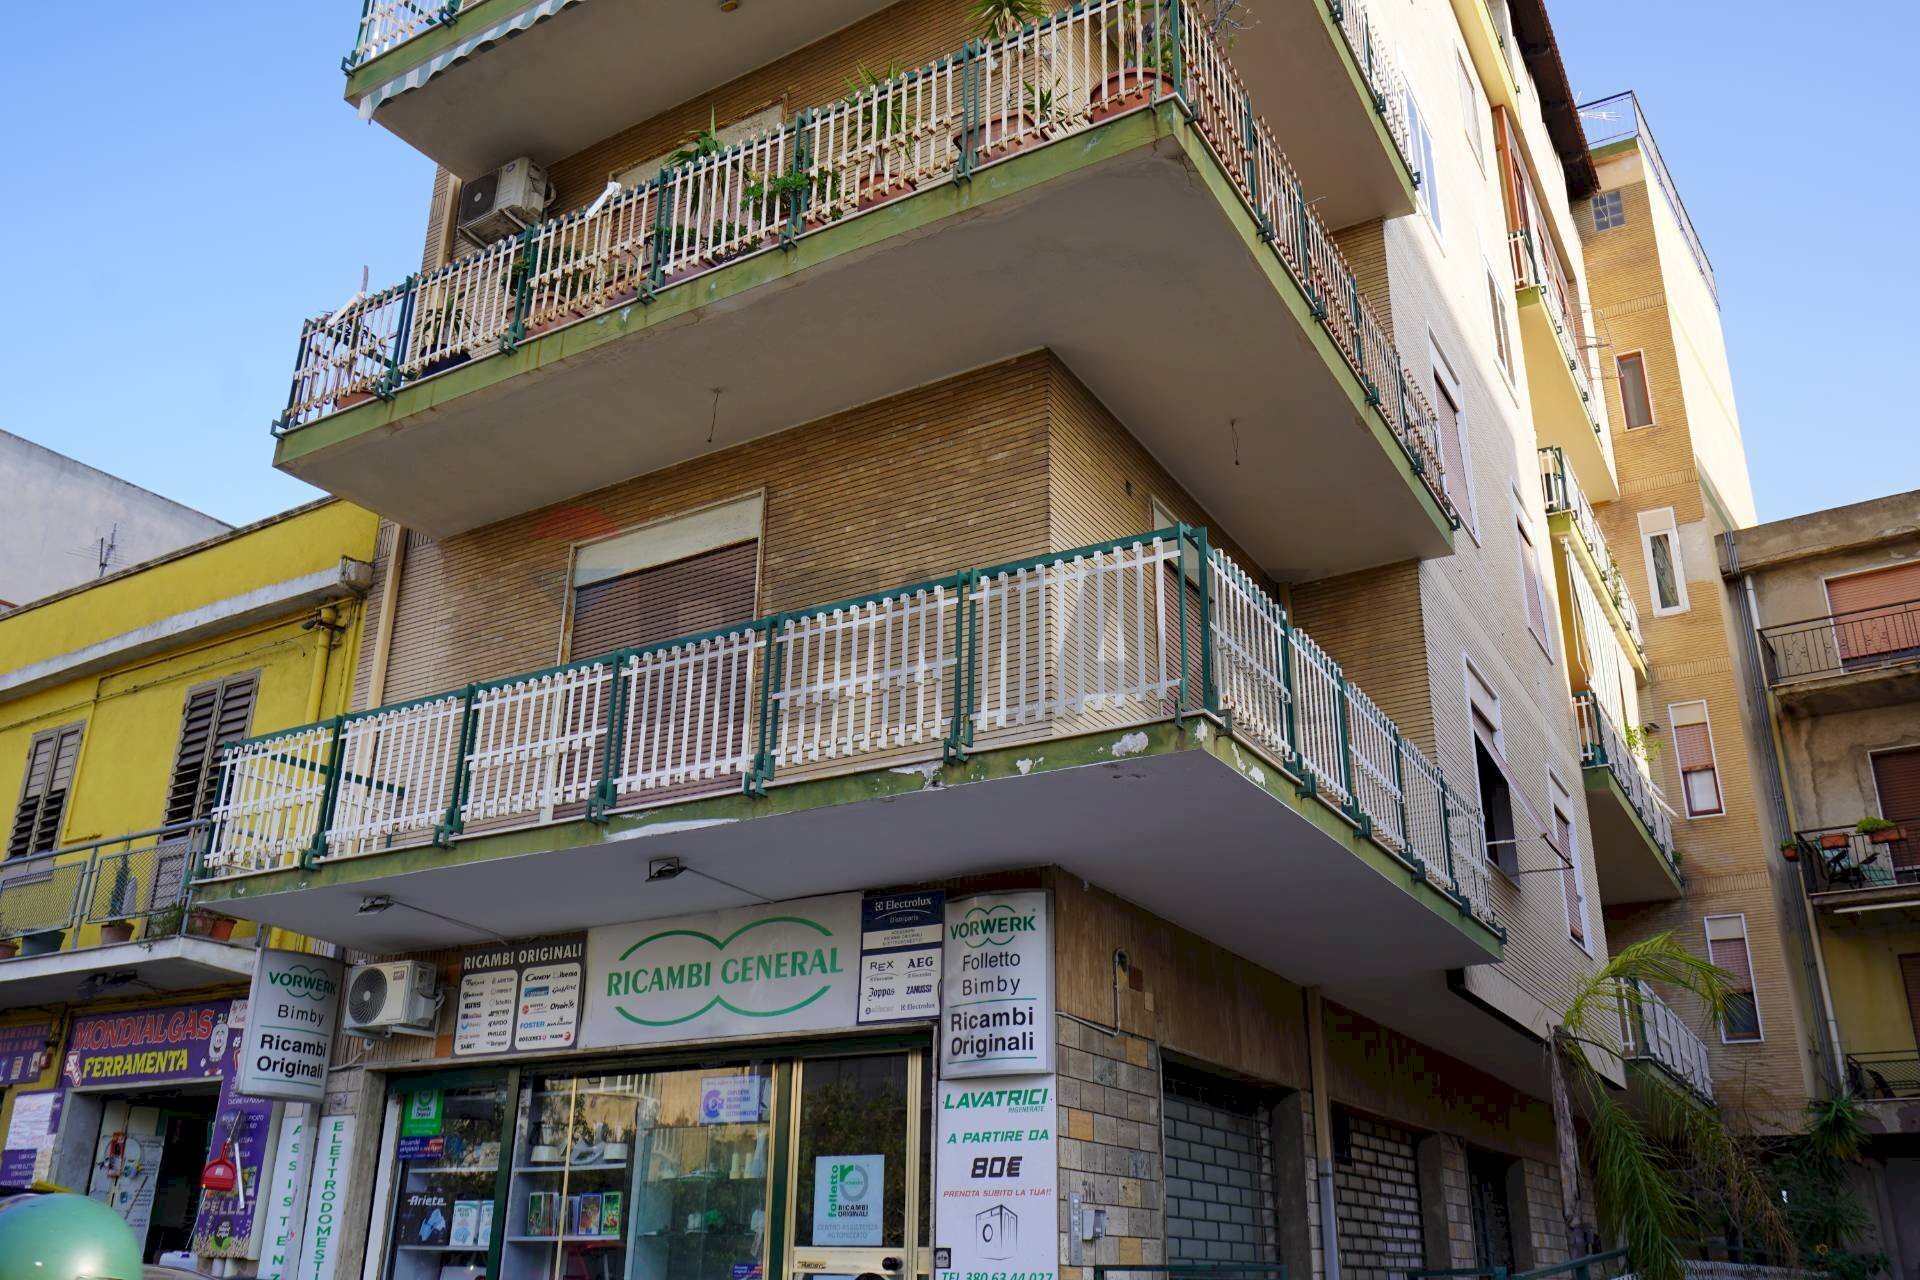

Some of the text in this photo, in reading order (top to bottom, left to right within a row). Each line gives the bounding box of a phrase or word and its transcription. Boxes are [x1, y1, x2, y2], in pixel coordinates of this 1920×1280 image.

[885, 897, 932, 910] Electrolux
[950, 915, 1036, 941] VORWERK
[463, 943, 582, 970] RICAMBI ORIGINALI
[869, 960, 894, 972] REX
[907, 956, 934, 969] AEG
[962, 952, 1021, 972] Folletto
[606, 947, 844, 996] RICAMBI GENERAL
[268, 971, 337, 996] VORWERK
[906, 983, 934, 995] ZANUSSI
[962, 975, 1021, 996] Bimby
[277, 1004, 325, 1027] Bimby
[906, 1002, 936, 1011] Electrolux
[73, 1008, 215, 1051] MONDIALGAS
[519, 1020, 546, 1030] FOSTER
[950, 1007, 1034, 1032] Ricambi
[260, 1034, 327, 1058] Ricambi
[950, 1032, 1034, 1058] Originali
[82, 1048, 189, 1079] FERRAMENTA
[256, 1055, 324, 1079] Originali
[944, 1088, 1049, 1110] LAVATRICI
[1008, 1105, 1045, 1113] RIGENERATE
[946, 1129, 1049, 1144] A PARTIRE DA
[971, 1156, 1023, 1179] 80€
[409, 1195, 447, 1206] Ariete
[943, 1190, 980, 1198] PRENOTA
[983, 1189, 1014, 1197] SUBITO
[837, 1210, 869, 1218] ORIGINALI
